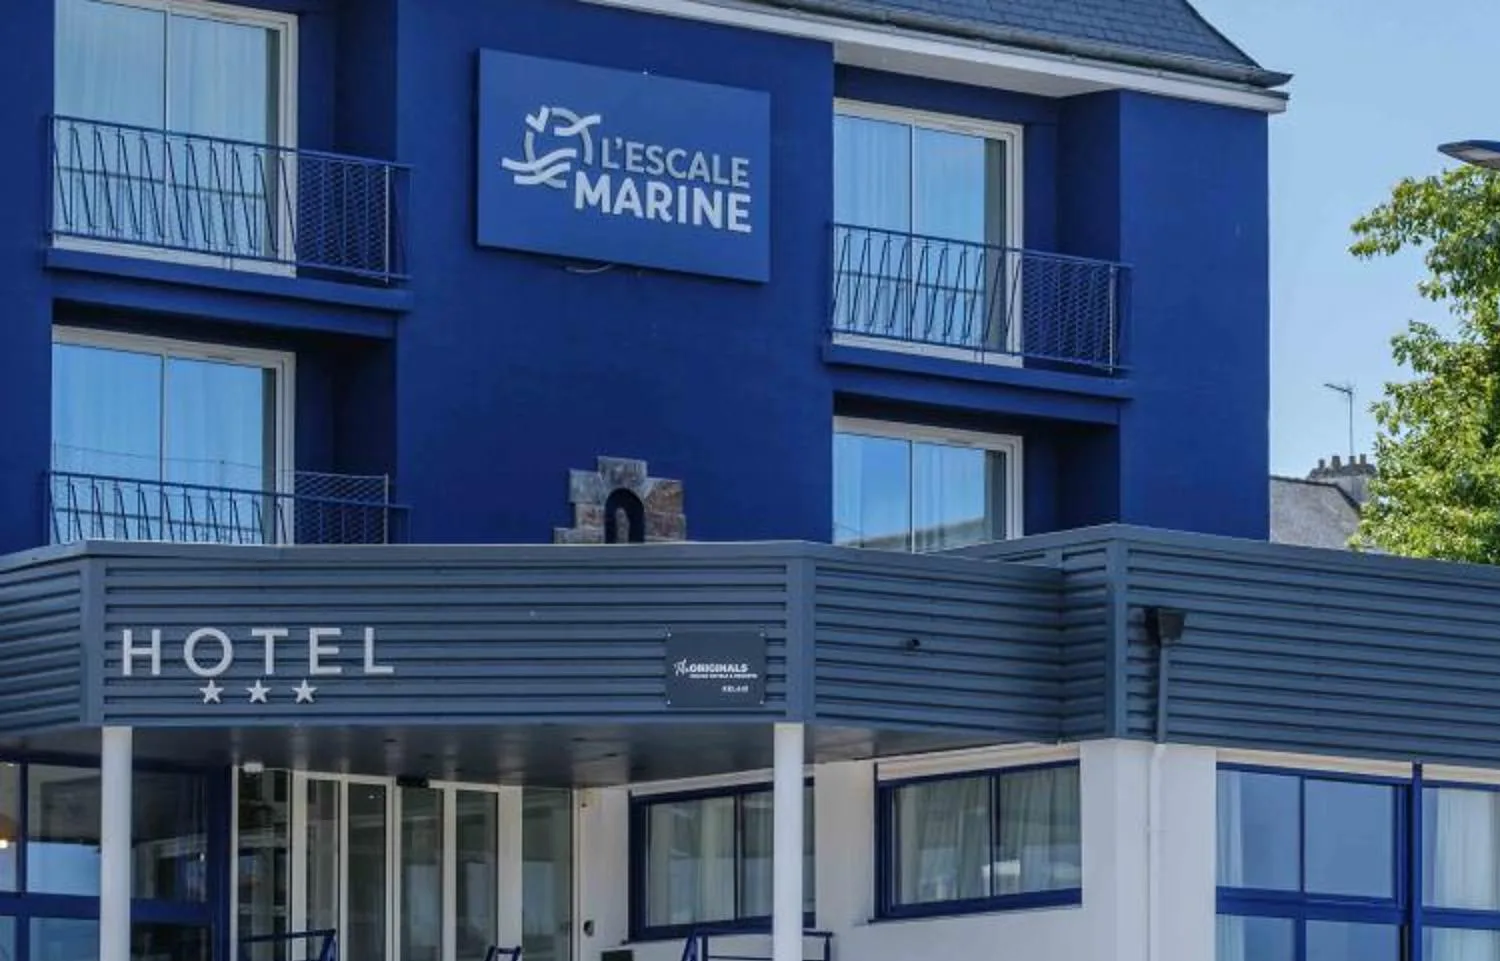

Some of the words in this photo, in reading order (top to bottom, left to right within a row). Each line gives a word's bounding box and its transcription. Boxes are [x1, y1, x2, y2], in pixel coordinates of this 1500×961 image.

[601, 137, 750, 188] L'ESCALE
[574, 171, 752, 233] MARINE
[122, 627, 394, 676] HOTEL
